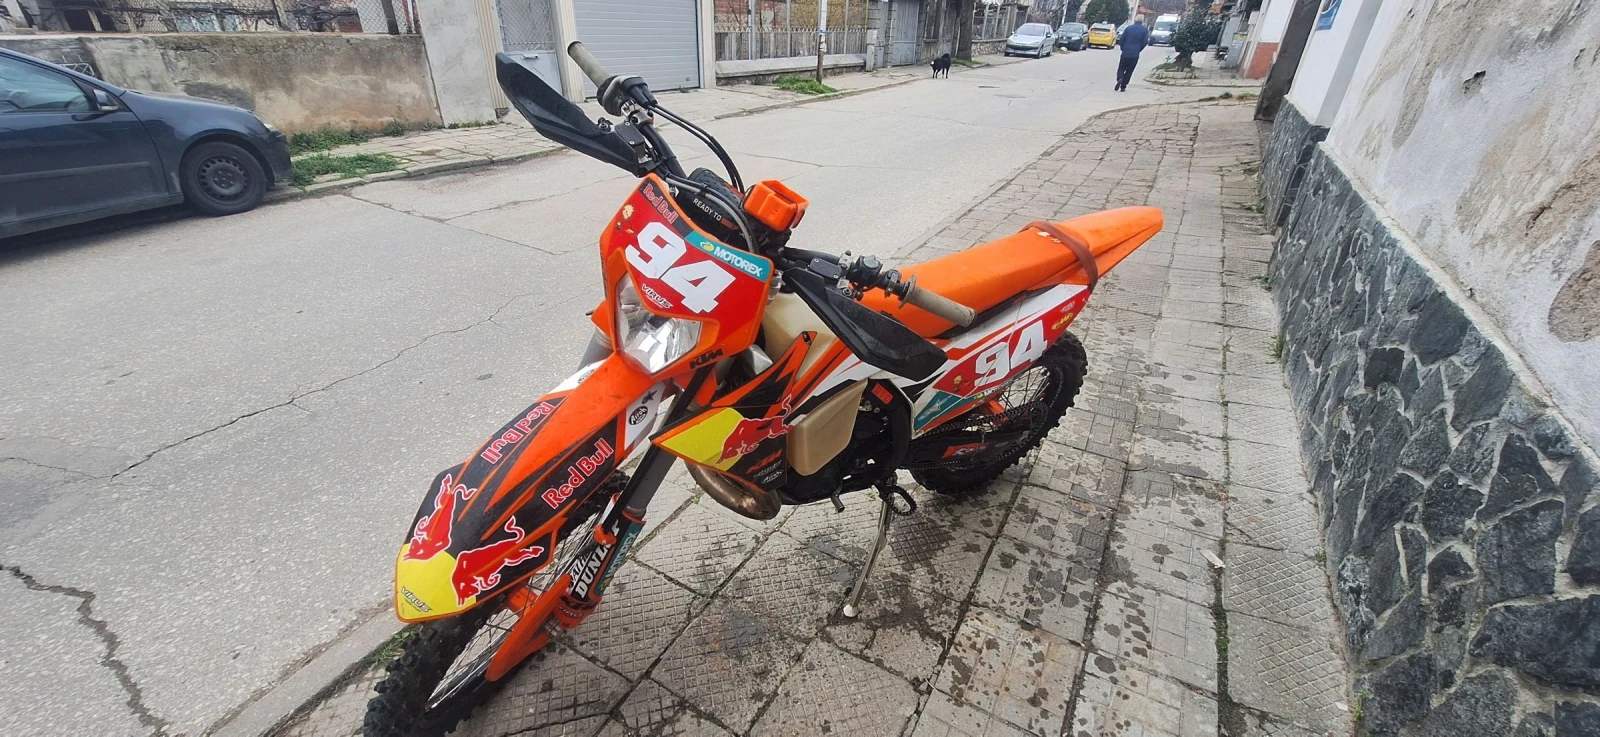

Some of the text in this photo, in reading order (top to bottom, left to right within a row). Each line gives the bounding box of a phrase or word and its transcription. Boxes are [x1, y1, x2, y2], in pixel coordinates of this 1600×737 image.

[643, 183, 679, 224] Red Bull
[692, 198, 722, 222] READY TO
[625, 221, 736, 314] 94
[713, 246, 763, 277] MOTOREX
[641, 283, 673, 308] VIRUS
[974, 319, 1048, 387] 94
[480, 401, 556, 464] Red Bull
[541, 438, 615, 510] Red Bull
[575, 519, 620, 599] DUNL
[401, 586, 433, 612] VIRUS
